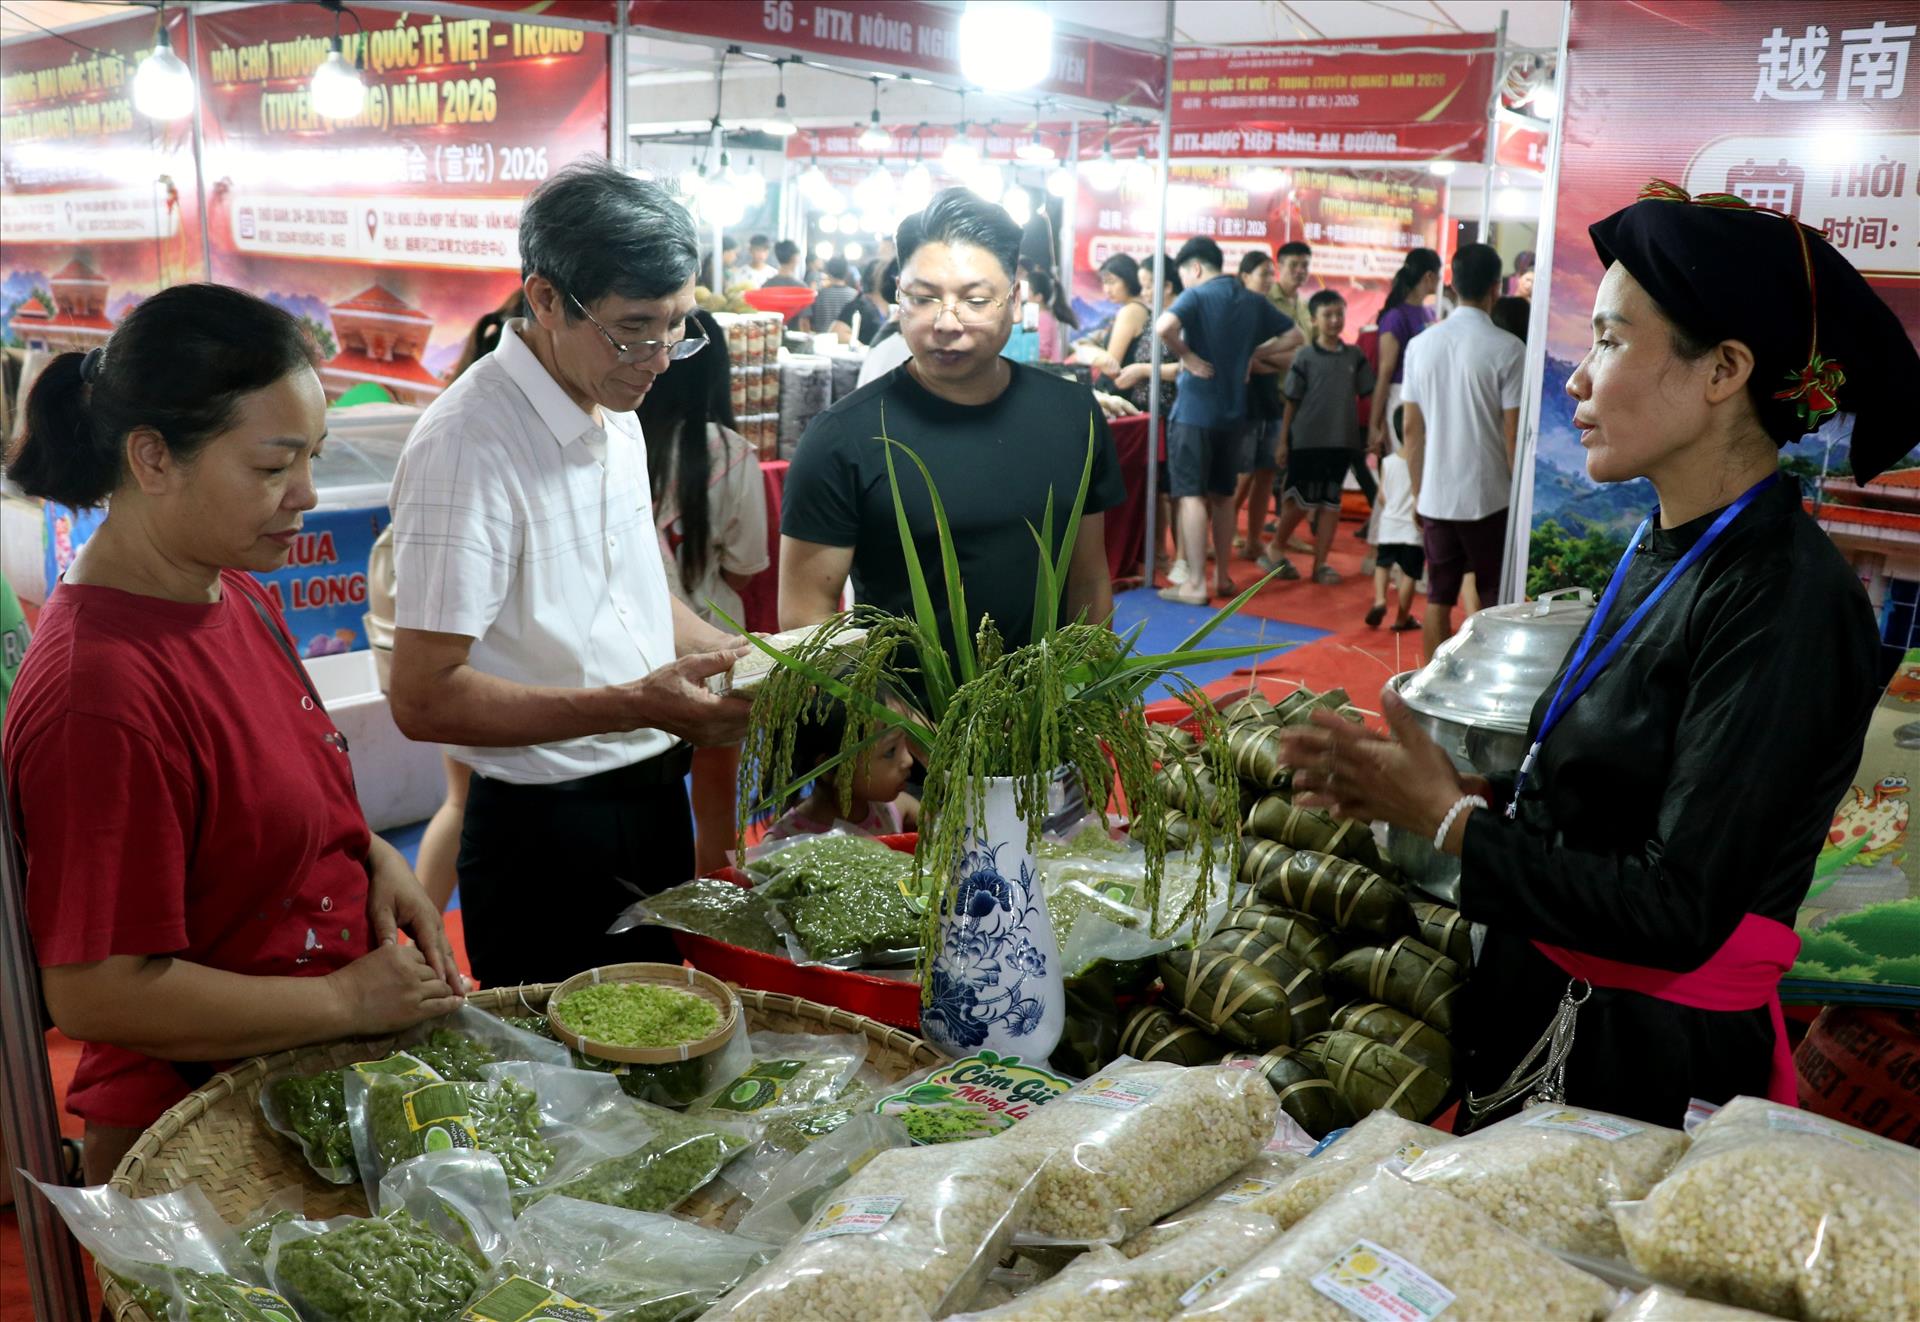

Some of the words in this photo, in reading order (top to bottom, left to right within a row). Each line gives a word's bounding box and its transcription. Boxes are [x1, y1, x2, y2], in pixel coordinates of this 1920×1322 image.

[238, 39, 270, 87] CHỢ
[370, 12, 419, 74] QUỐC
[447, 19, 491, 71] VIỆT
[764, 1, 793, 33] 56
[814, 7, 853, 43] HTX
[859, 11, 912, 53] NÔNG
[1752, 21, 1917, 103] 越南
[392, 75, 438, 126] NĂM
[442, 77, 497, 124] 2026
[500, 146, 549, 181] 2026
[1830, 154, 1907, 198] THỜI
[293, 572, 367, 610] LONG
[949, 1064, 1014, 1091] Cốm
